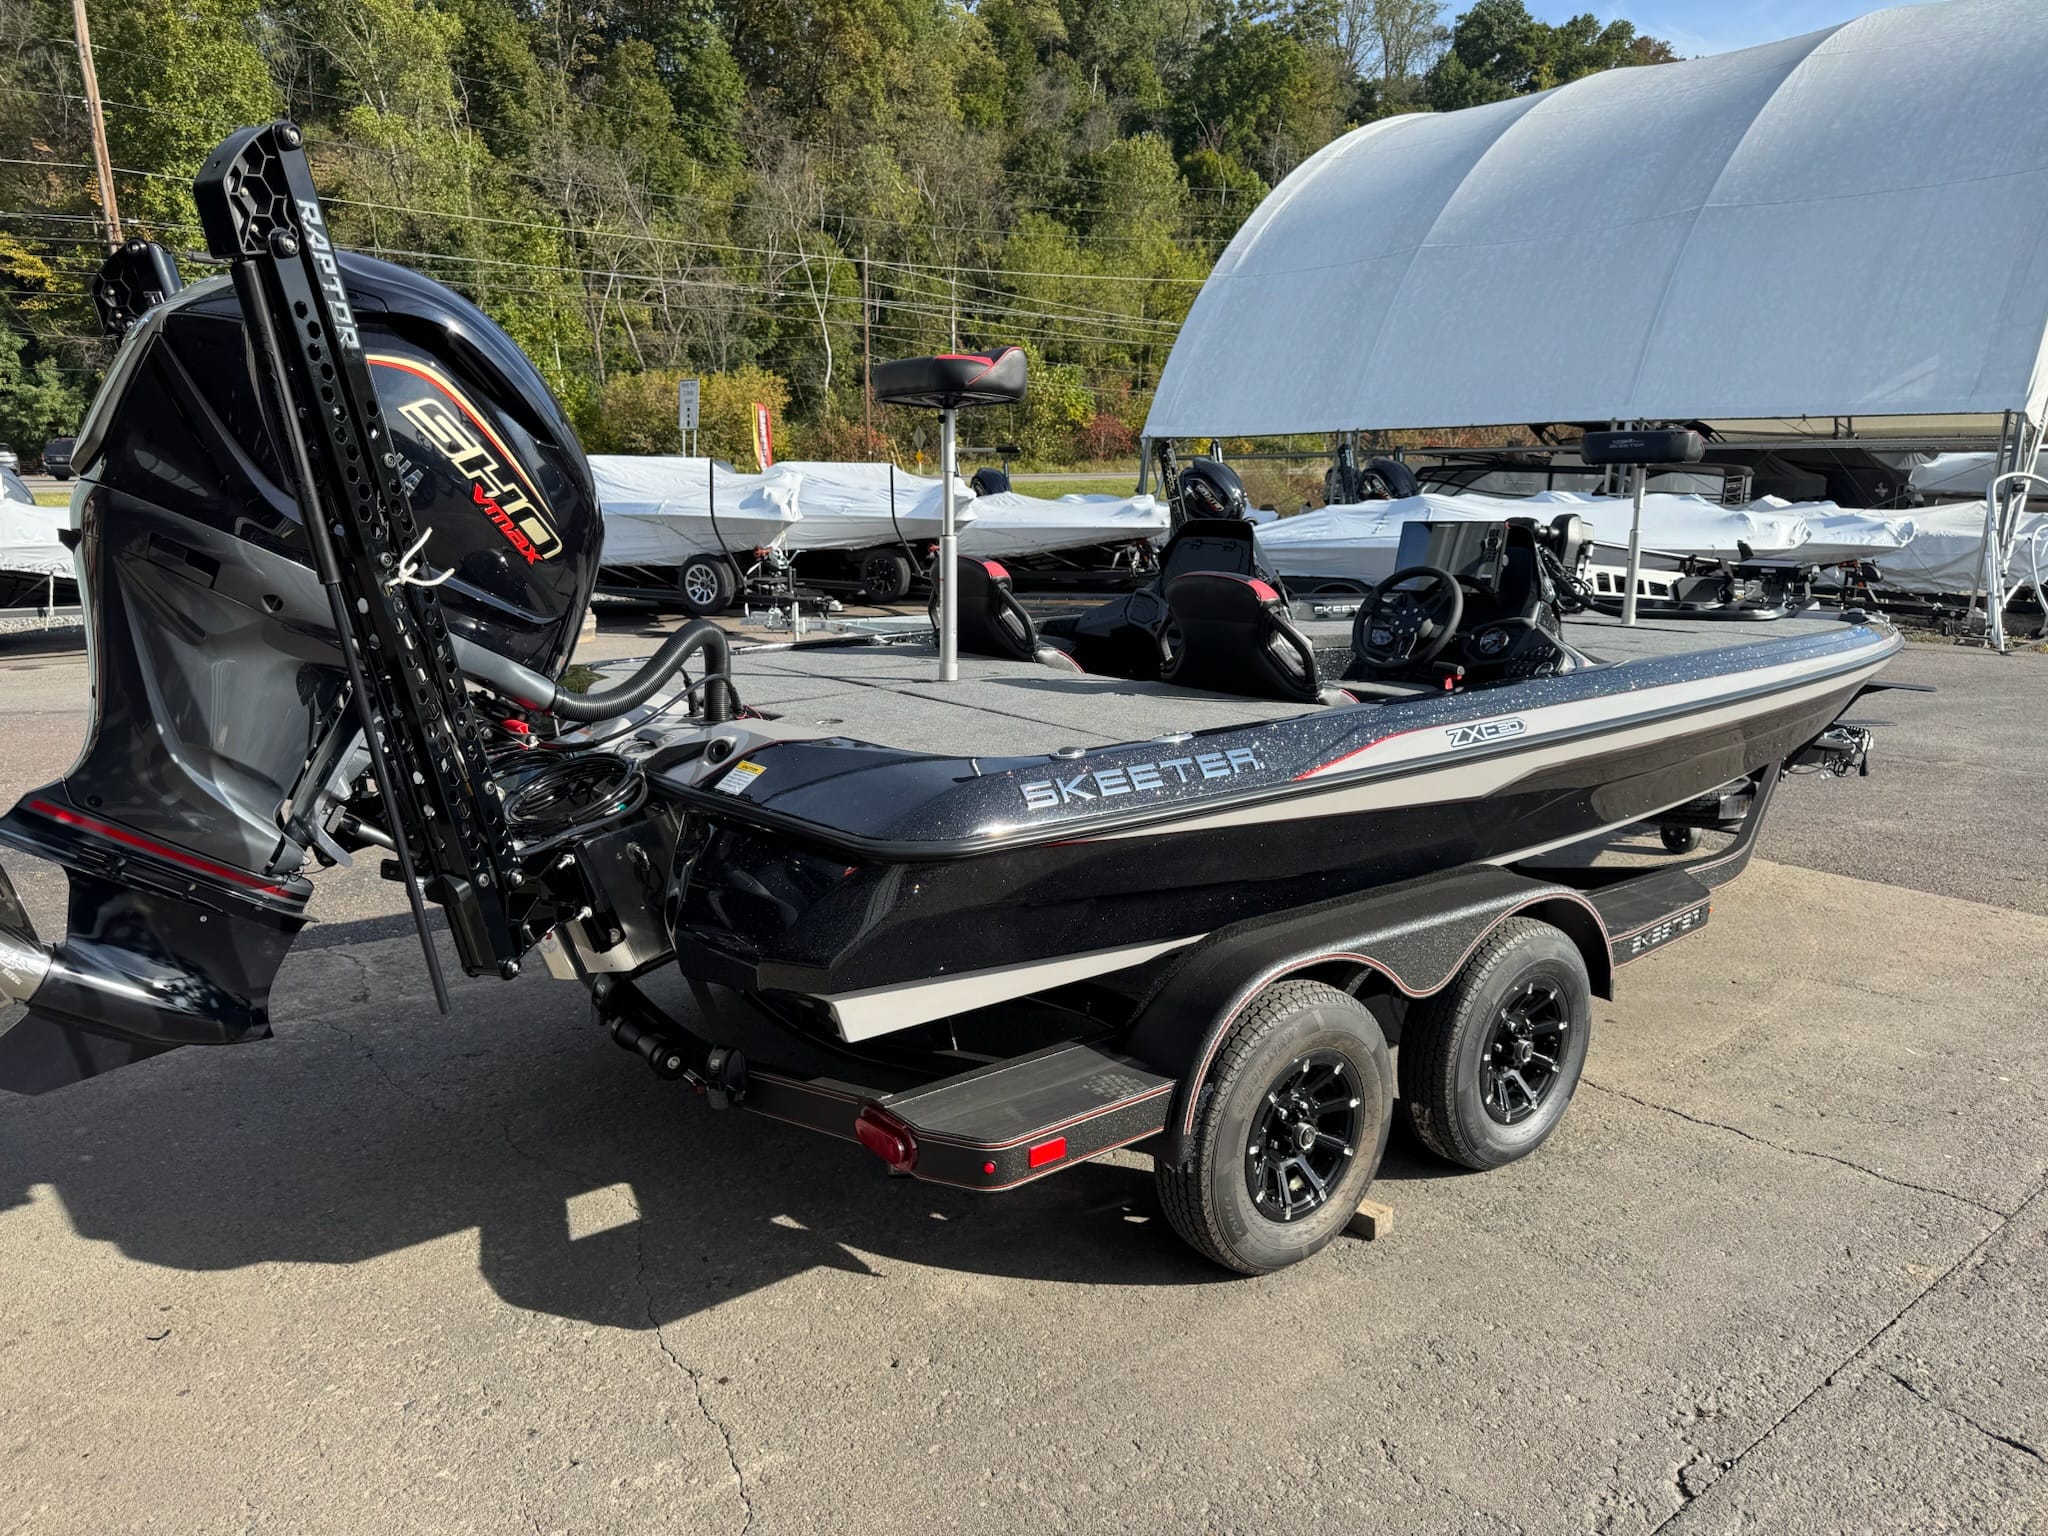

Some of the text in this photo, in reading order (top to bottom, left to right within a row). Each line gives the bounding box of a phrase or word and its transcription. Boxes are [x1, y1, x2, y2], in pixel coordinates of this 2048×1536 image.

[296, 199, 361, 348] RAPTOR
[397, 398, 563, 560] SHO
[1314, 604, 1361, 615] SKEET
[1019, 747, 1259, 810] SKEETER
